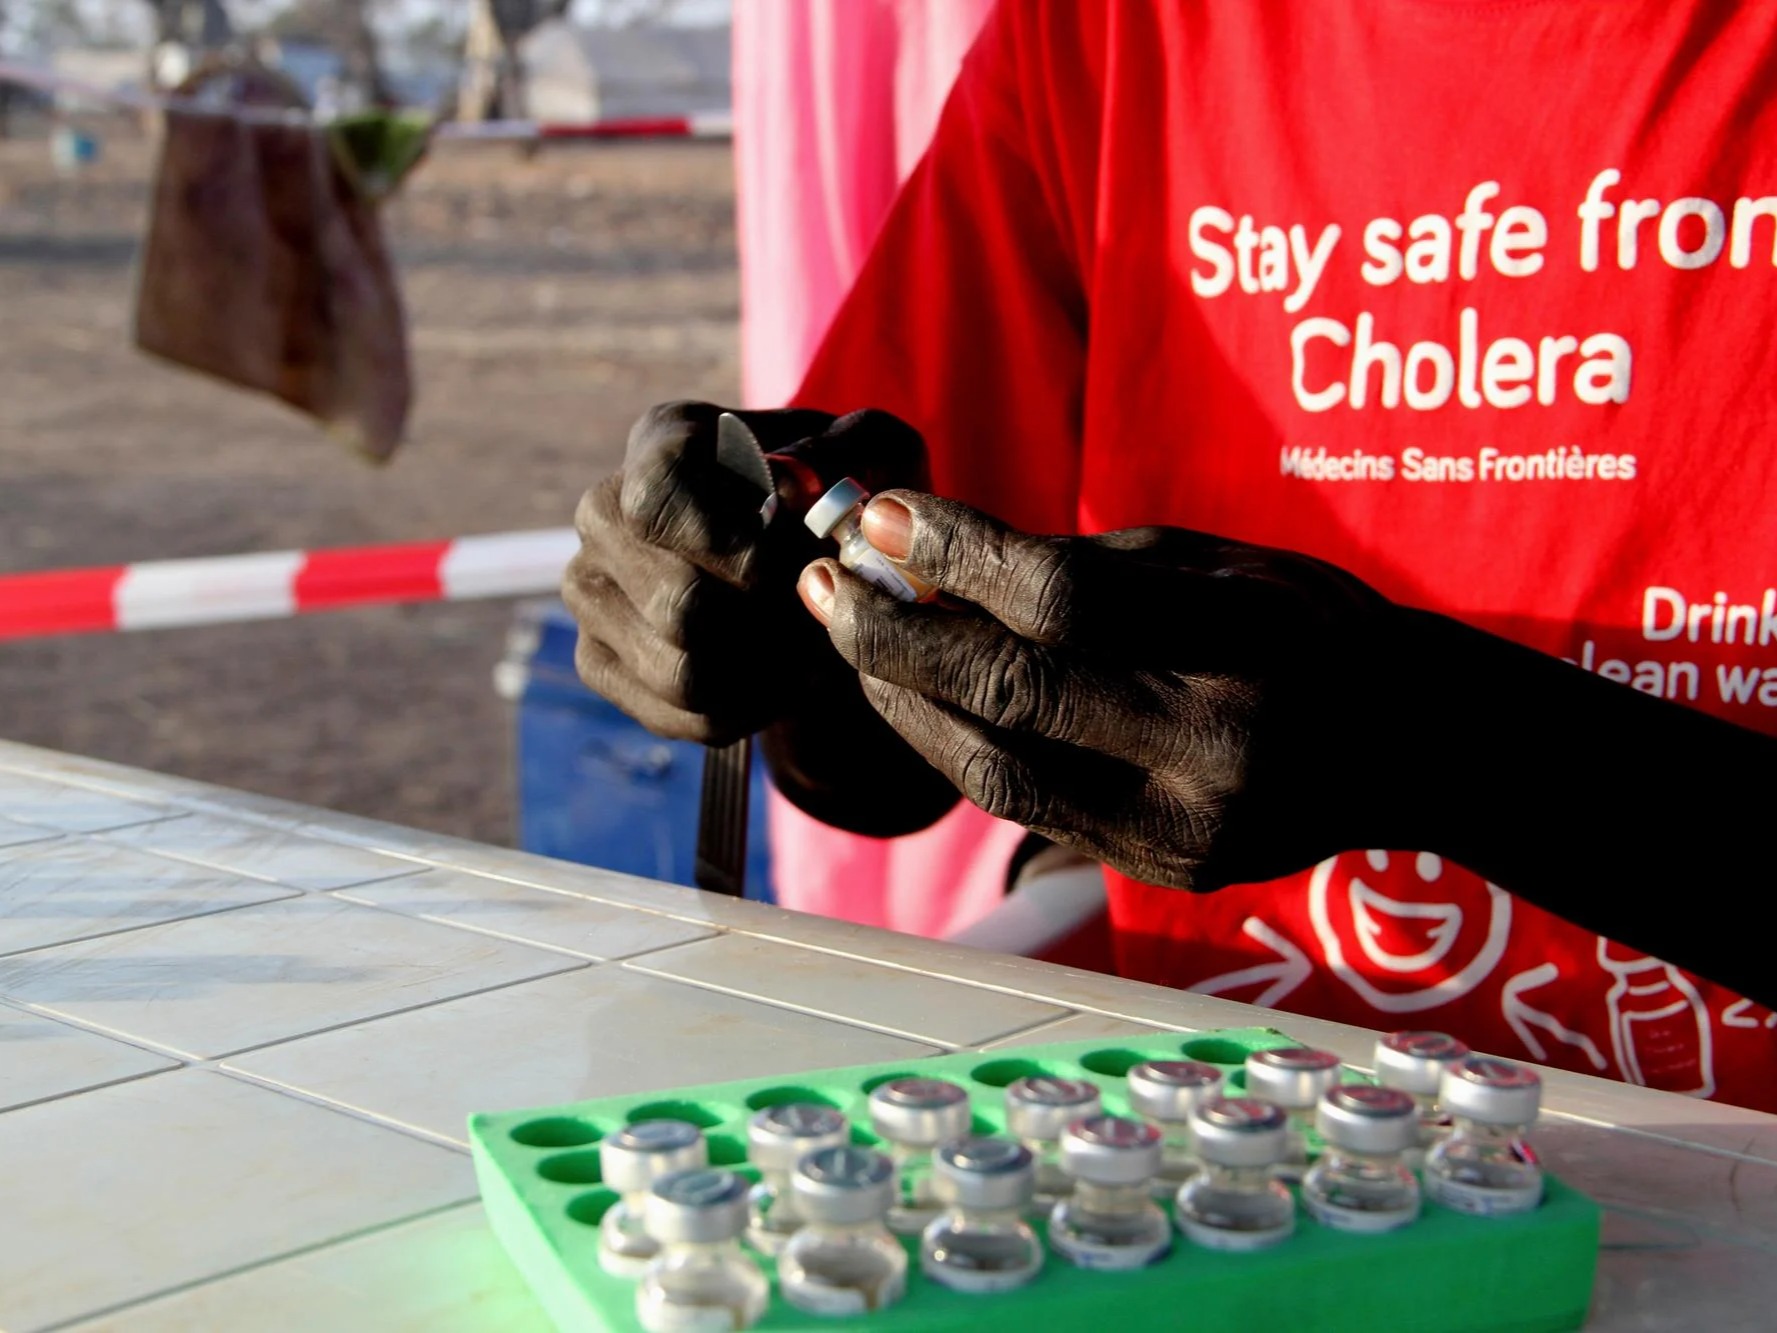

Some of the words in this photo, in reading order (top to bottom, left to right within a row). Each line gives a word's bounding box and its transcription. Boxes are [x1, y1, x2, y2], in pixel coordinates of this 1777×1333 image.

[1188, 205, 1342, 314] Stay
[1361, 180, 1548, 287] safe
[1290, 306, 1633, 413] Cholera
[1280, 445, 1395, 481] Médecins
[1401, 447, 1475, 482] Sans
[1479, 445, 1636, 481] Frontières
[1559, 639, 1699, 700] lean
